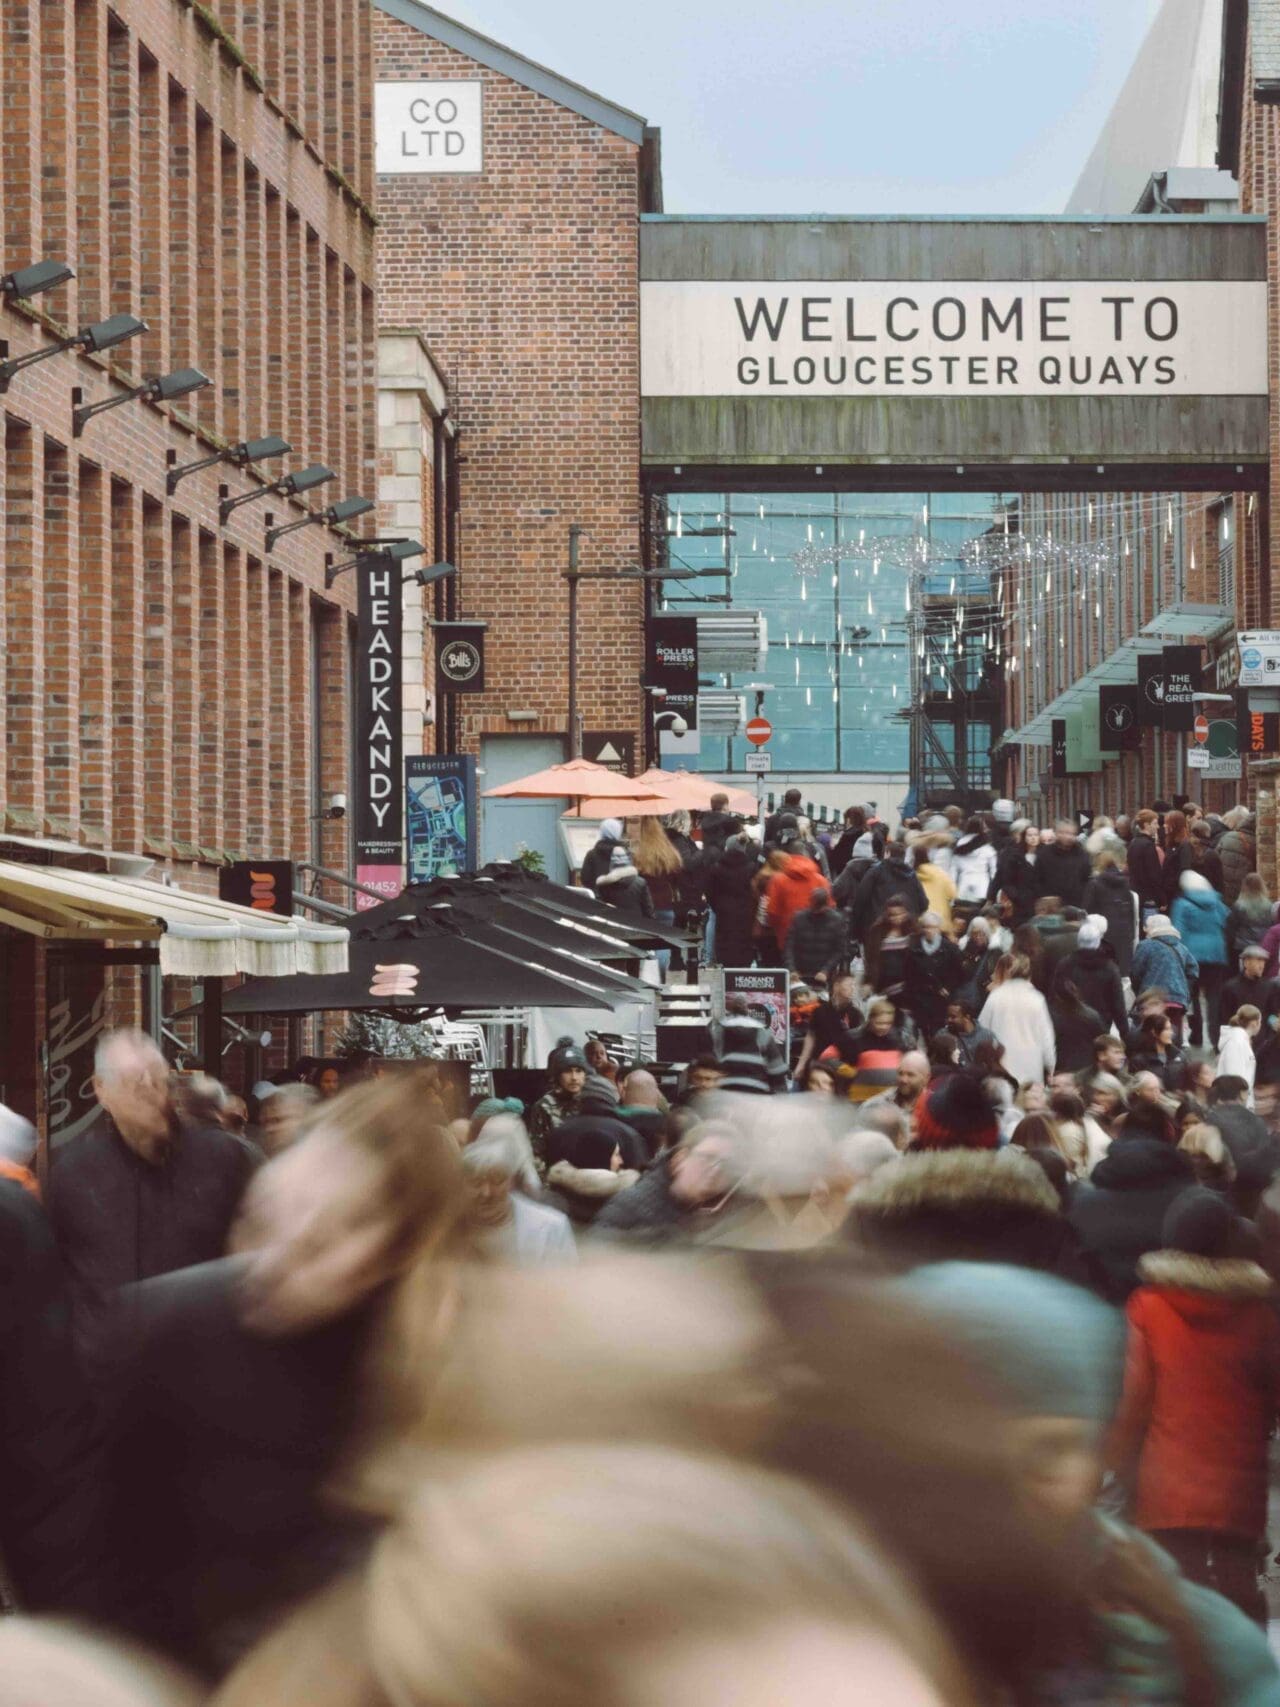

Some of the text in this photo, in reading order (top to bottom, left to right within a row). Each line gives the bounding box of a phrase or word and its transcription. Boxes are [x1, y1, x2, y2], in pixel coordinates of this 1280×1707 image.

[409, 98, 458, 124] CO
[401, 130, 465, 157] LTD
[733, 295, 1179, 343] WELCOME TO
[736, 355, 1177, 387] GLOUCESTER QUAYS
[656, 647, 694, 655] ROLLER
[1170, 674, 1190, 683] THE
[1168, 684, 1195, 693] REAL
[367, 571, 393, 828] HEADKANDY
[1165, 694, 1192, 703] GREE
[357, 840, 402, 848] HAIRDRESSING
